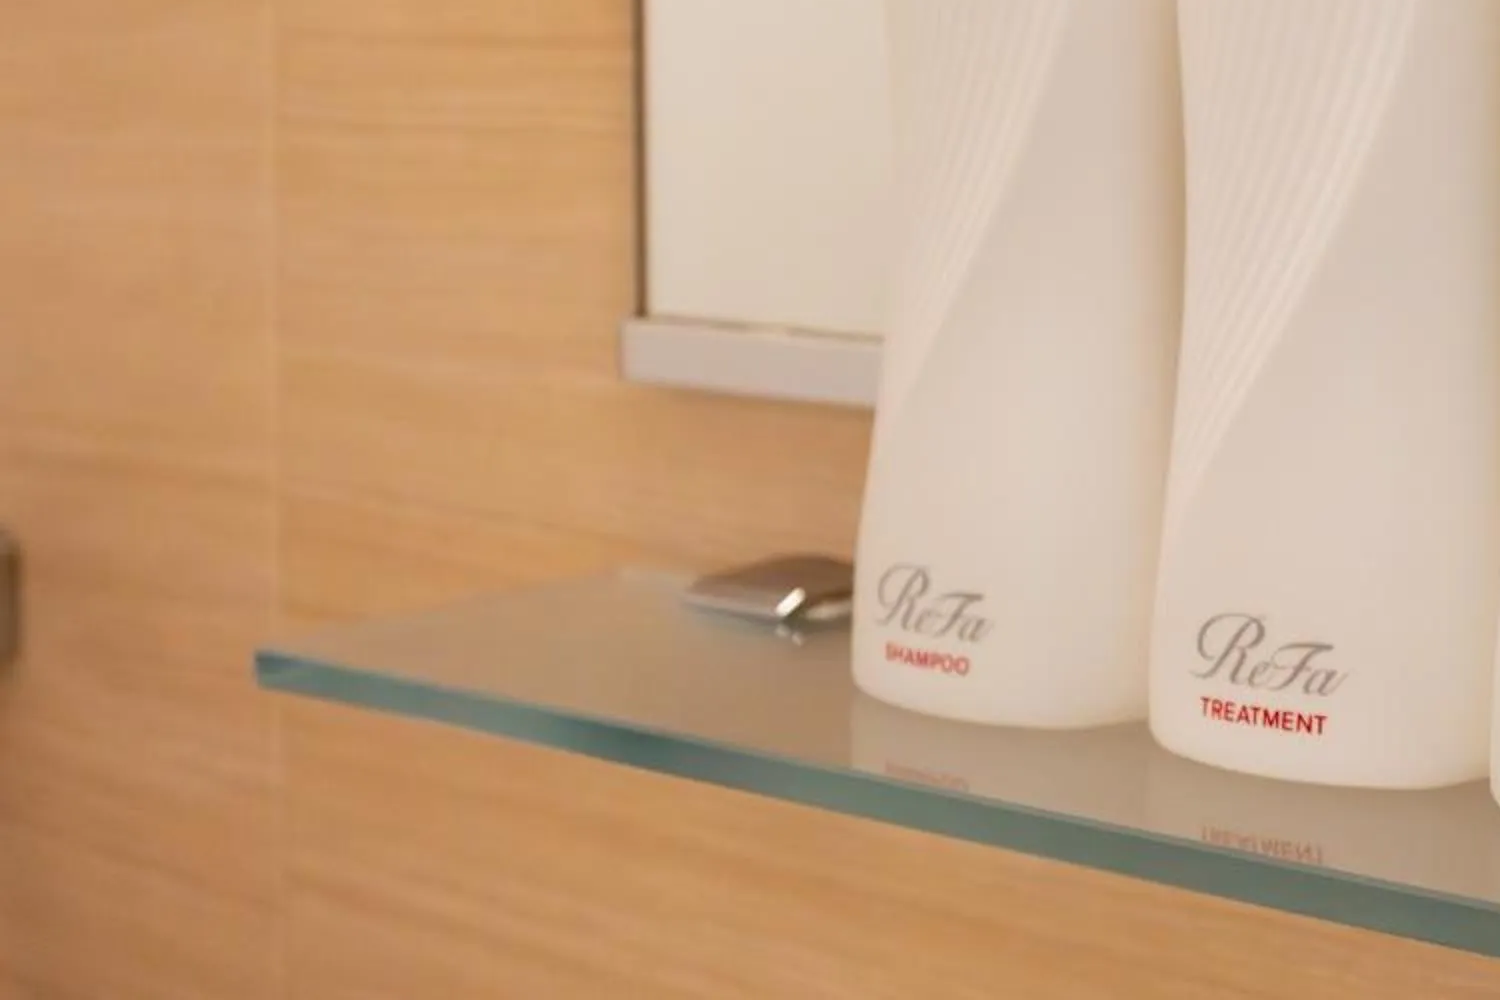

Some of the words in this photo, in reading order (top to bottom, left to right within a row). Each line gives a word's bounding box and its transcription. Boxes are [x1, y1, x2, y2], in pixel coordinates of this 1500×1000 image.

[876, 564, 992, 642] ReFa
[885, 642, 970, 676] SHAMPOO
[1191, 612, 1351, 696] ReFa
[1200, 697, 1328, 735] TREATMENT
